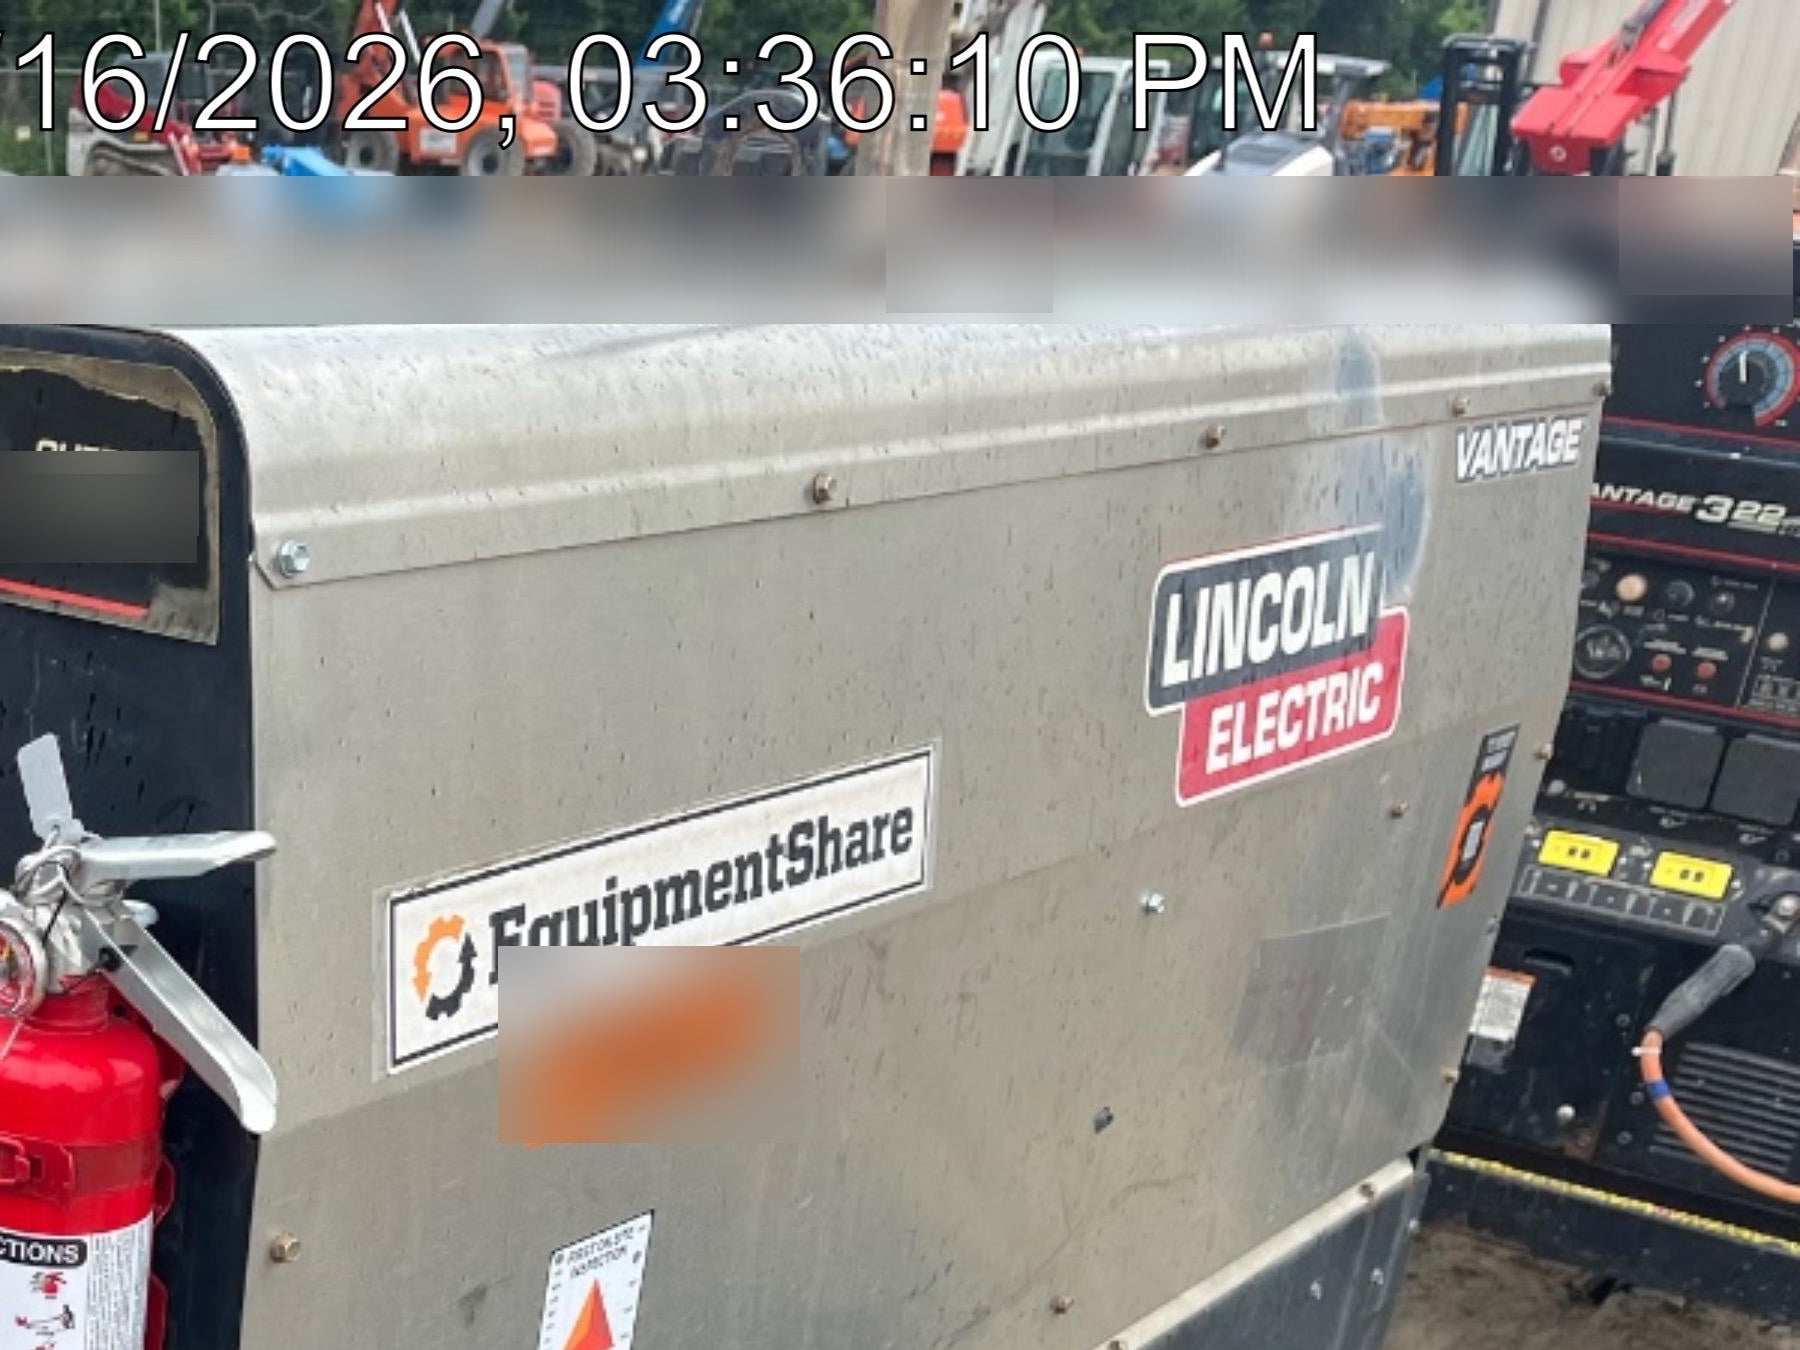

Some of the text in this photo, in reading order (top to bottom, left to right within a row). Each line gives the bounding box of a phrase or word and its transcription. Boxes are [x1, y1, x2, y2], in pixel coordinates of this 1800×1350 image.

[1456, 417, 1584, 481] VANTAGE
[1591, 481, 1694, 513] ANTAGE
[1696, 494, 1788, 531] 322
[1160, 551, 1375, 688] LINCOLN
[1205, 661, 1384, 775] ELECTRIC
